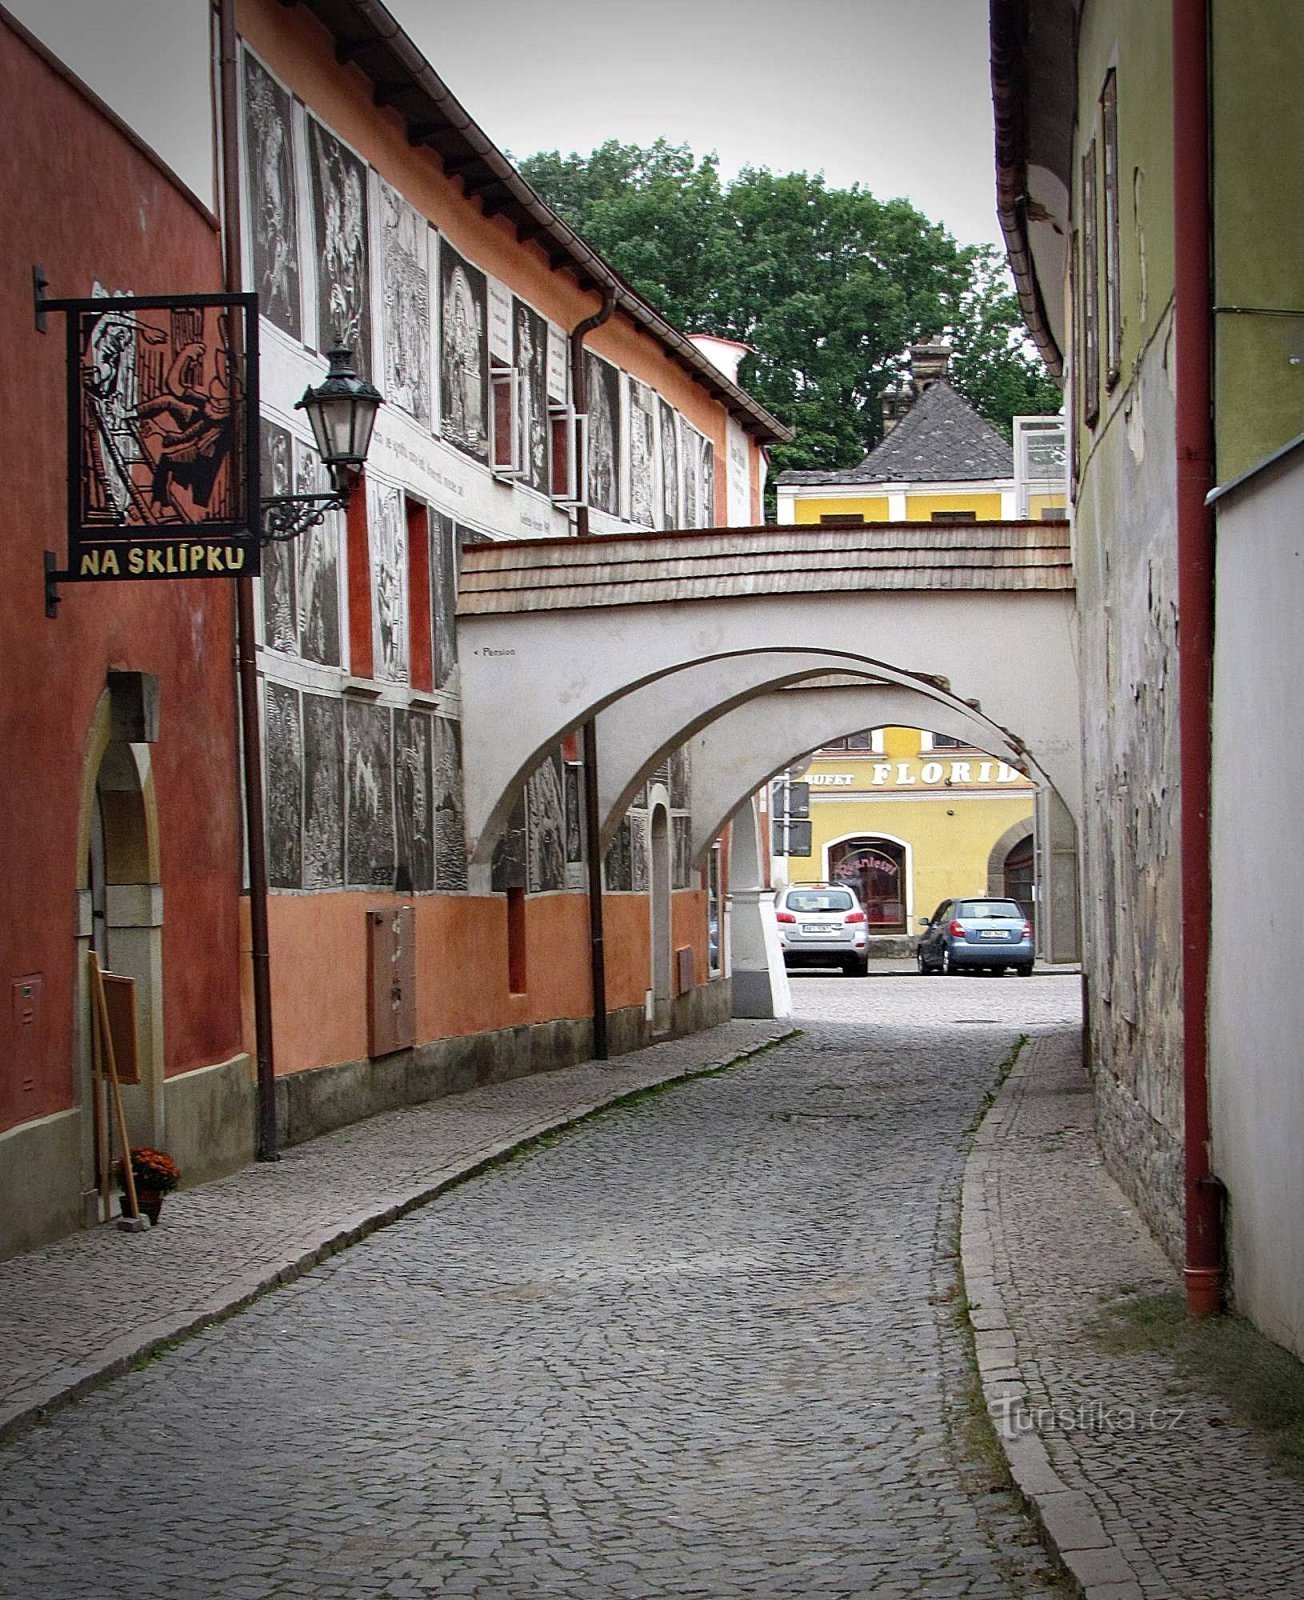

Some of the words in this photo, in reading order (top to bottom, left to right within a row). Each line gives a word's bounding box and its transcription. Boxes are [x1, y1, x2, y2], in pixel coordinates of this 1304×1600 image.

[80, 548, 120, 576] NA
[128, 543, 245, 574] SKLÍPKU
[482, 647, 516, 657] Pension
[807, 773, 855, 786] BUFET
[871, 761, 1031, 786] FLORID
